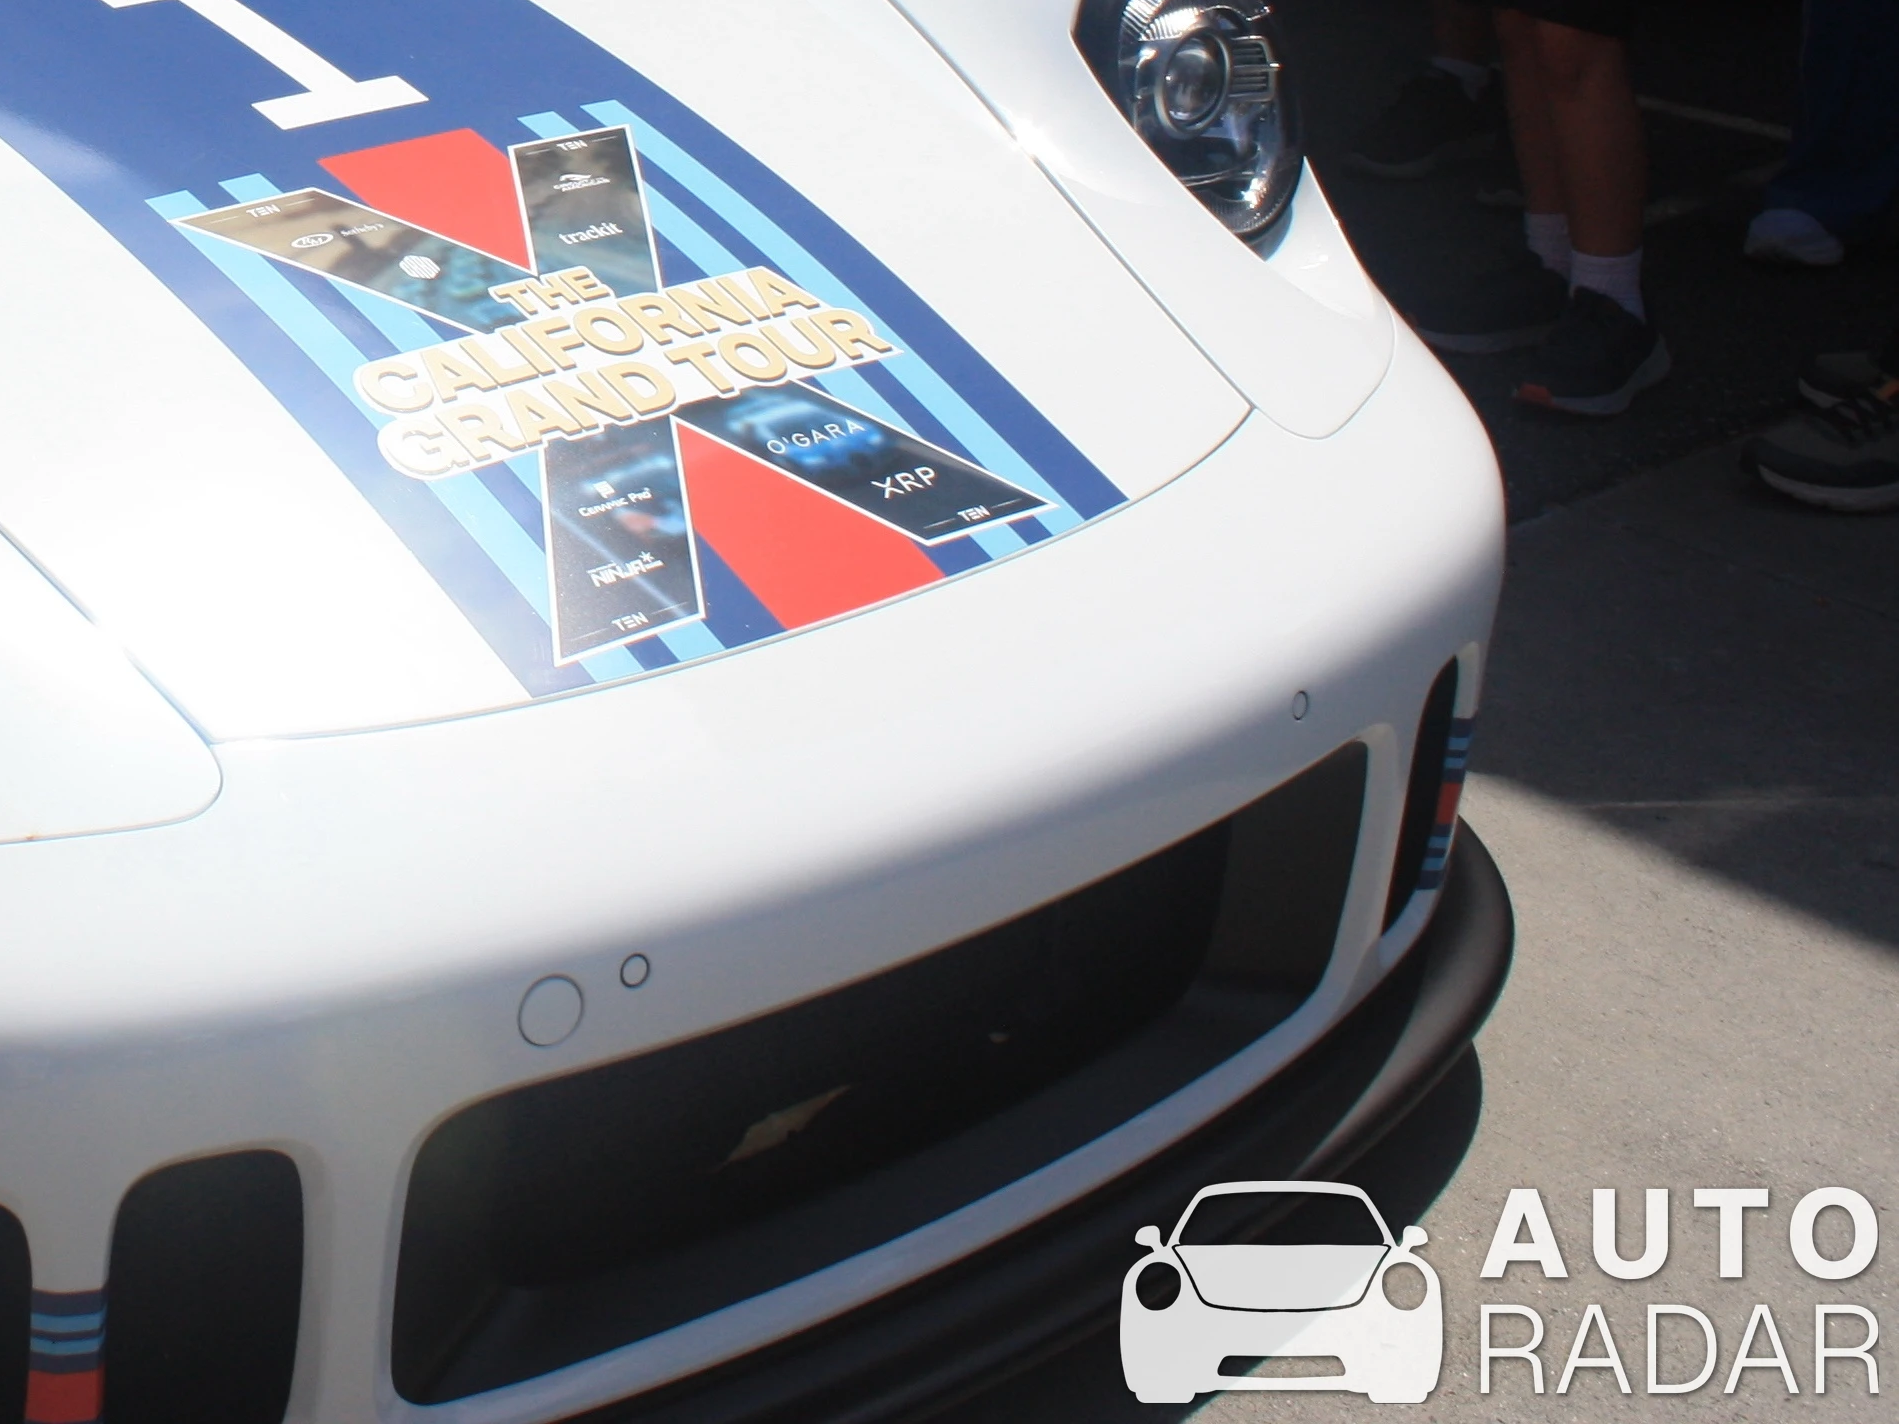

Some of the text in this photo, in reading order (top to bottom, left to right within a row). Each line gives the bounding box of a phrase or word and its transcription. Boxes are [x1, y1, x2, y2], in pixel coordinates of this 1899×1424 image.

[556, 139, 588, 152] TEN
[246, 204, 281, 218] TEN
[559, 222, 623, 245] trackit
[497, 268, 613, 315] THE
[361, 268, 821, 412] CALIFORNIA
[386, 307, 893, 473] GRAND TOUR
[766, 418, 866, 455] O'GARA
[871, 466, 937, 499] XRP
[957, 505, 991, 522] TEN
[589, 560, 646, 587] NINJA
[611, 612, 649, 631] TEN
